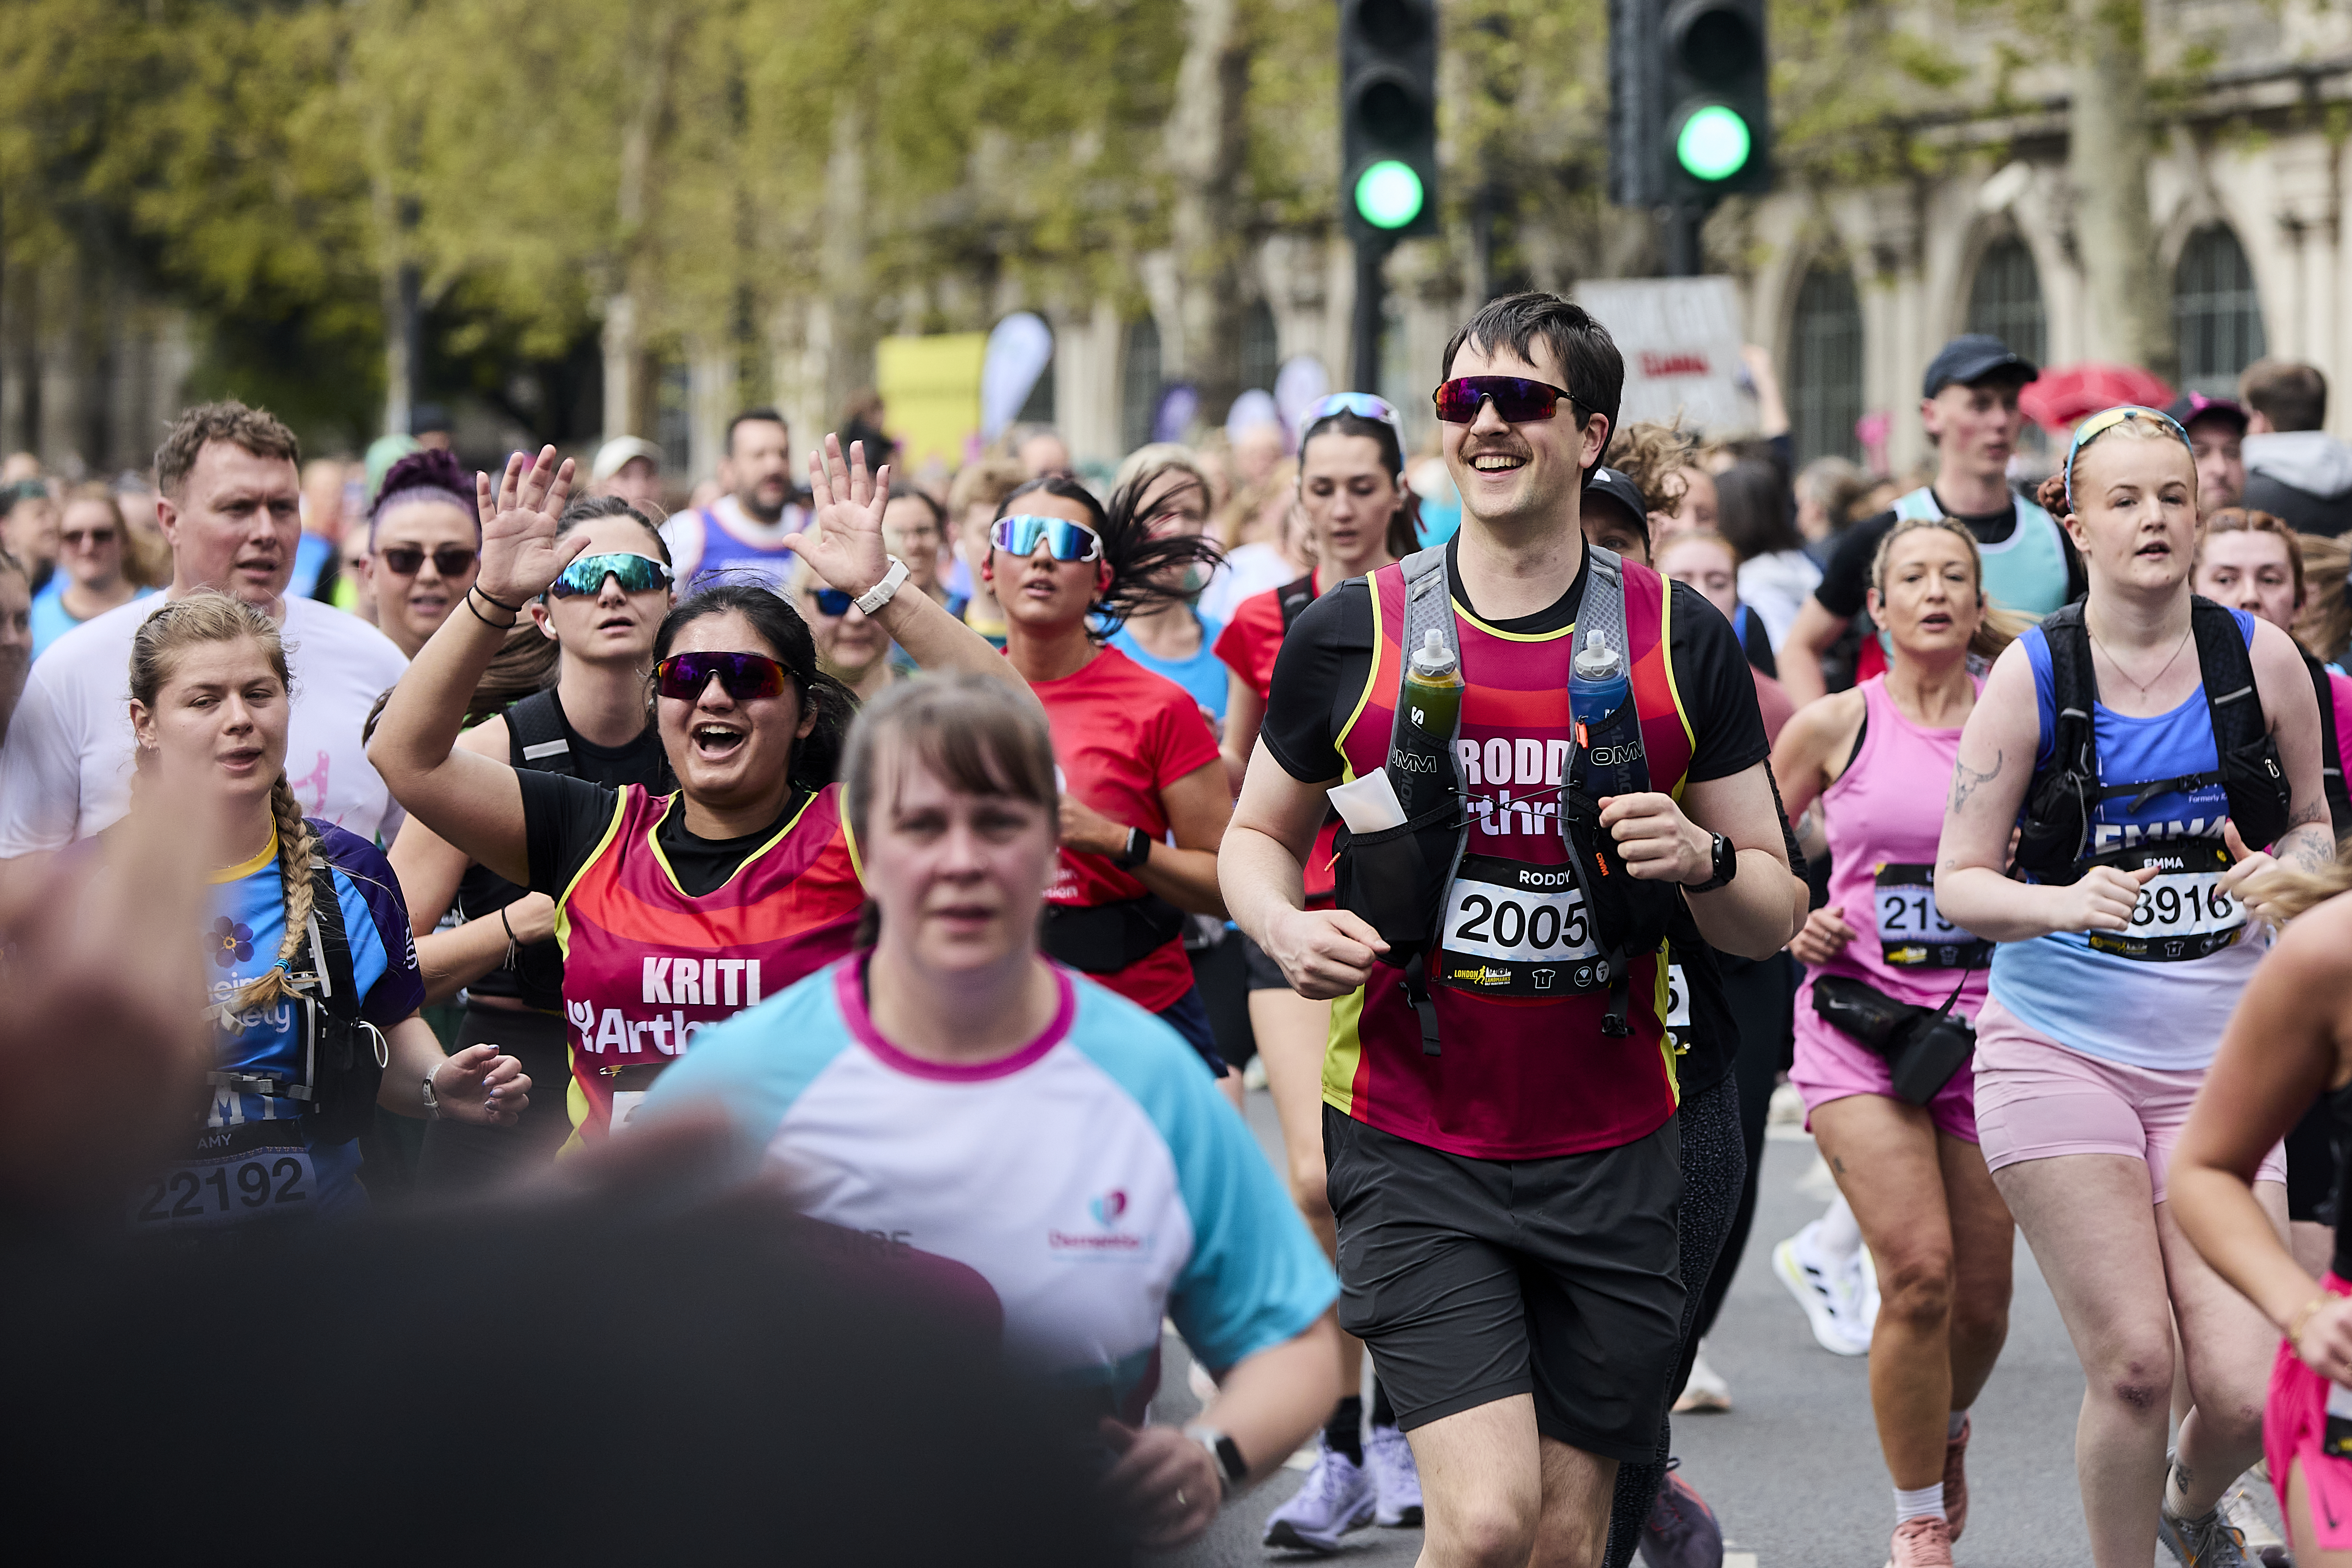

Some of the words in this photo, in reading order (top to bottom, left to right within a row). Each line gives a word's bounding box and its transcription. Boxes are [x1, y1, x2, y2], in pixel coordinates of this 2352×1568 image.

[1457, 738, 1570, 785] RODD
[1519, 870, 1570, 886] RODDY
[2144, 856, 2184, 869] EMMA
[1456, 894, 1594, 950] 2005
[643, 957, 760, 1006] KRITI
[1454, 969, 1479, 978] LONDON
[1601, 971, 1605, 979] 7
[207, 1072, 282, 1128] MY
[197, 1134, 231, 1149] AMY
[137, 1157, 306, 1222] 22192
